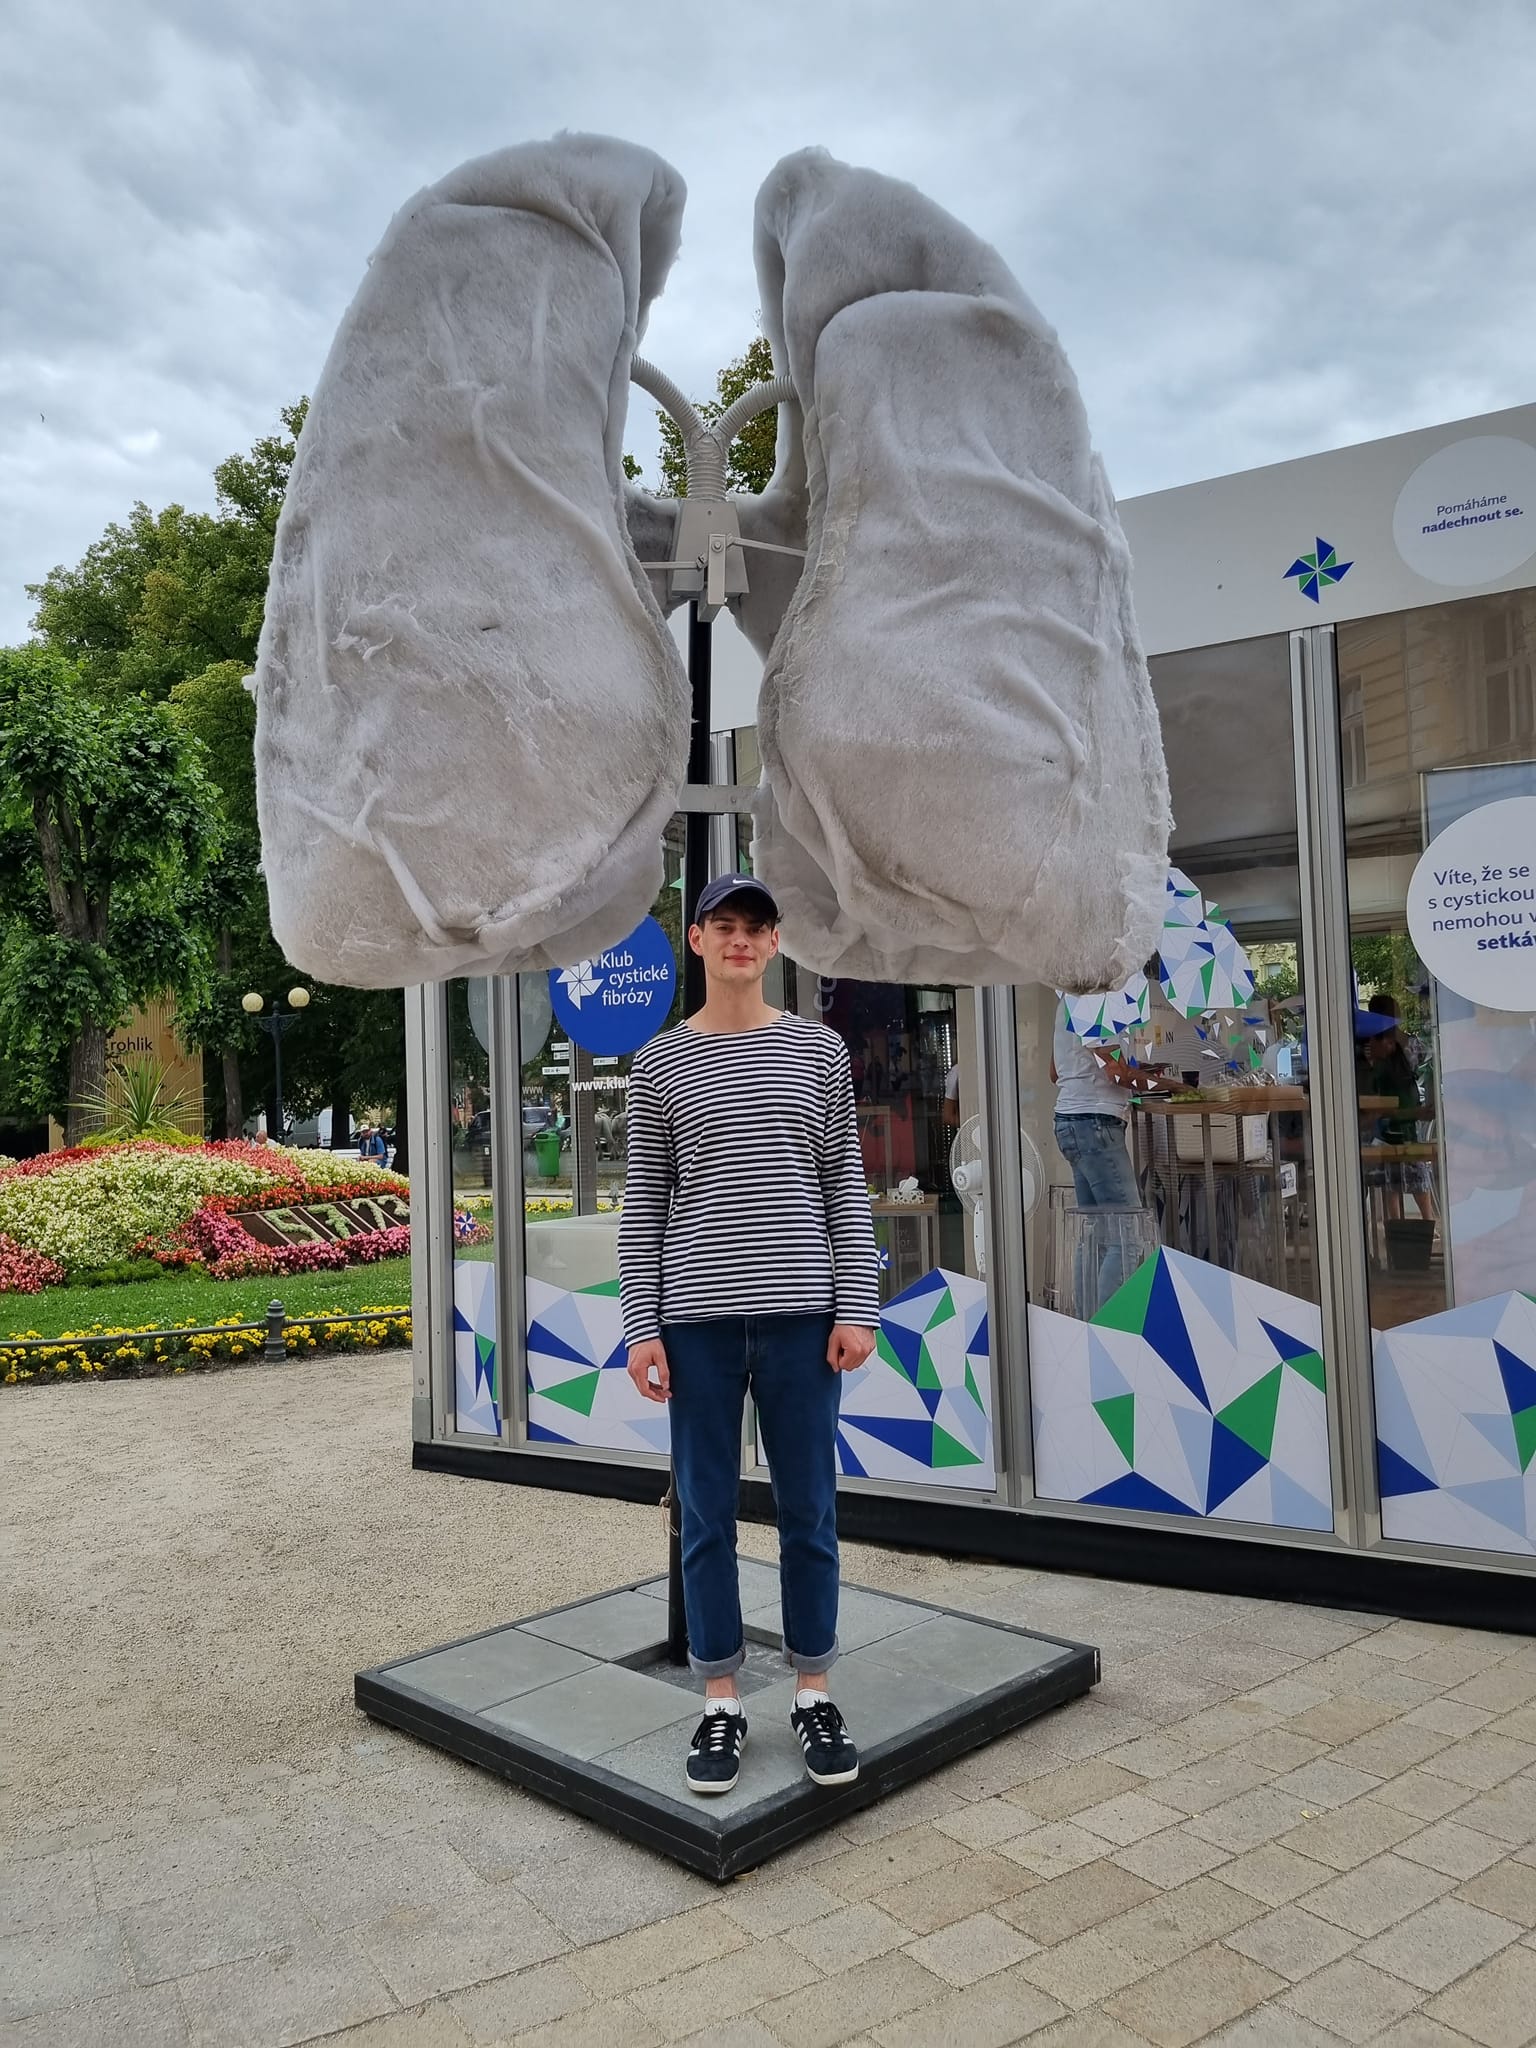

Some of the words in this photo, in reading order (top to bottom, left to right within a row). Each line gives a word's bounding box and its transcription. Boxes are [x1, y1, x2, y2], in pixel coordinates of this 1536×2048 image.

[1436, 495, 1507, 516] Pomáháme
[1422, 509, 1502, 534] nadechnout
[1504, 507, 1524, 518] se.
[1433, 868, 1477, 886] Víte,
[1481, 865, 1503, 881] že
[1508, 865, 1530, 879] se
[1428, 898, 1437, 909] s
[1443, 887, 1534, 911] cystickou
[1432, 911, 1523, 931] nemohou
[600, 951, 633, 969] Klub
[609, 963, 669, 988] cystické
[602, 987, 653, 1006] fibrózy
[110, 1036, 153, 1051] rohlik
